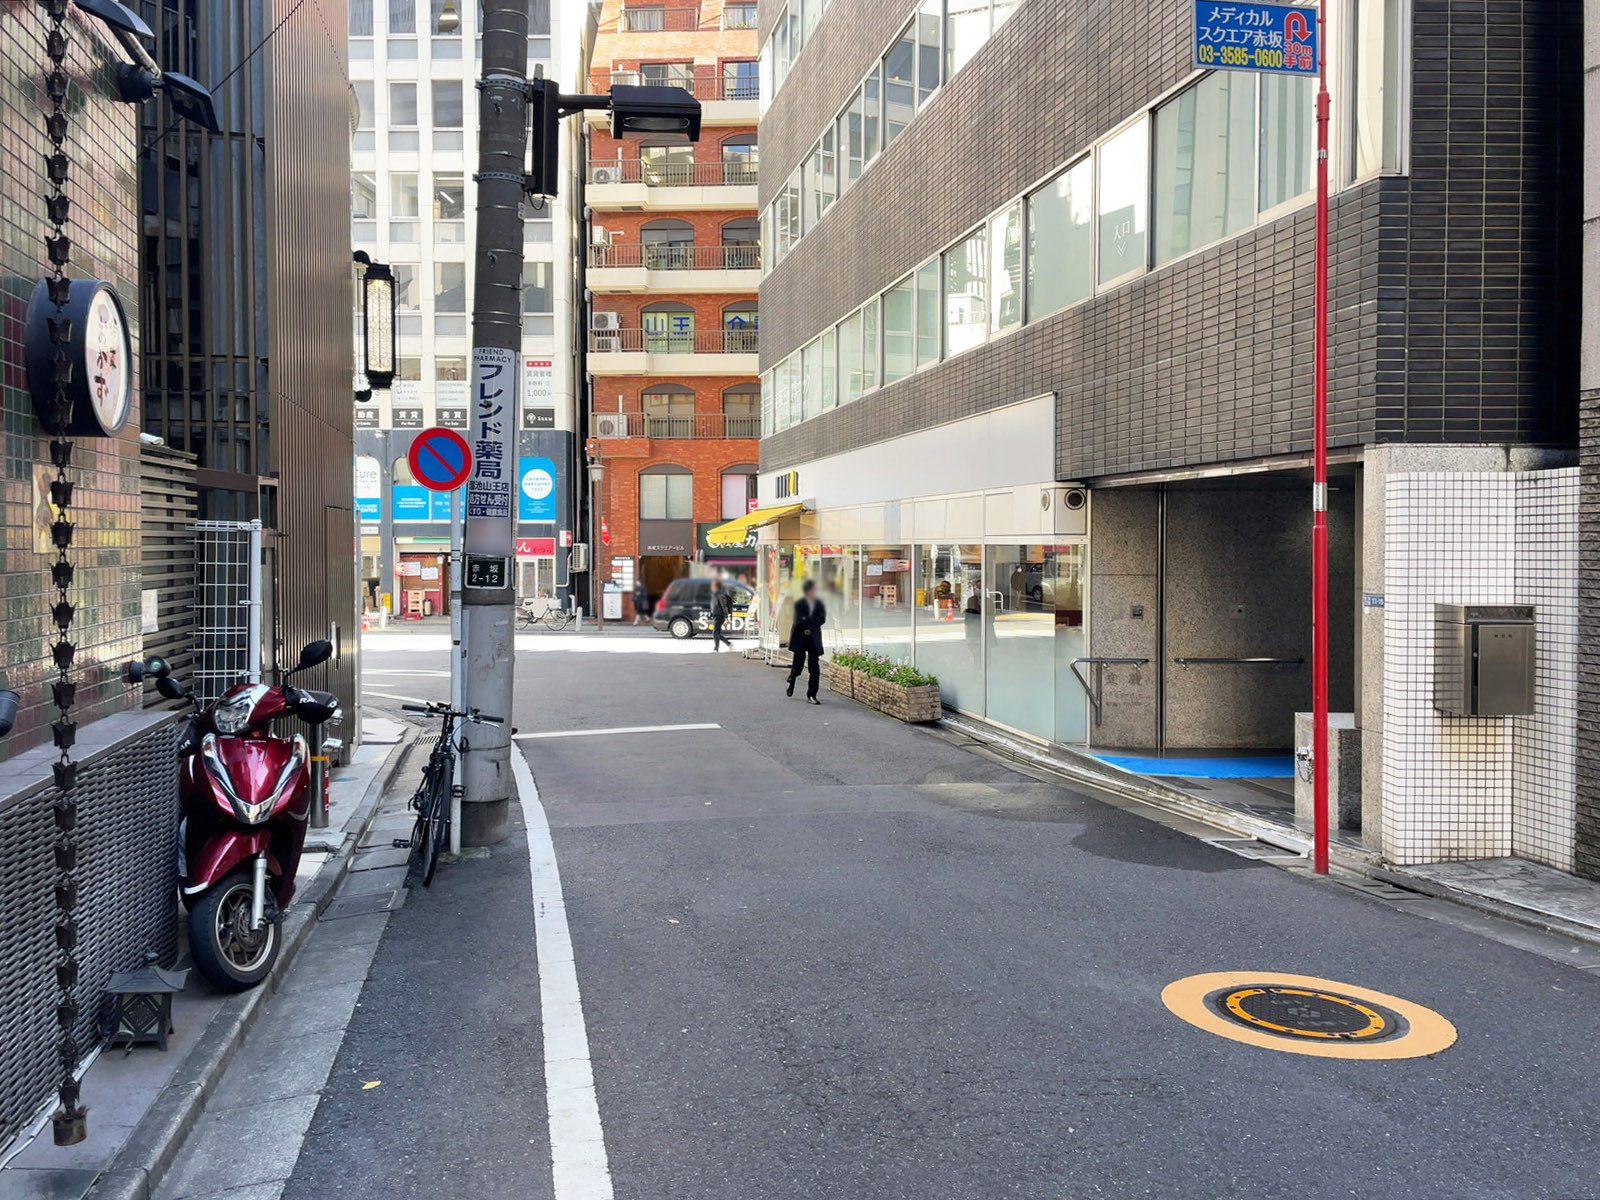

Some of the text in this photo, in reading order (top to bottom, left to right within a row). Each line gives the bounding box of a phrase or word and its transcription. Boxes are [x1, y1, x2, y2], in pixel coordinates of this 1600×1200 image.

[1208, 7, 1273, 26] メディカル
[1199, 26, 1283, 49] スクエア赤坂
[1199, 44, 1282, 68] 03-3585-0600
[1283, 42, 1312, 55] 30m
[1283, 55, 1312, 69] 手前
[1113, 220, 1130, 242] 入口
[479, 348, 504, 356] FRIEND
[475, 364, 503, 479] フレンド薬局
[471, 564, 499, 573] 赤坂
[471, 573, 499, 583] 2-12
